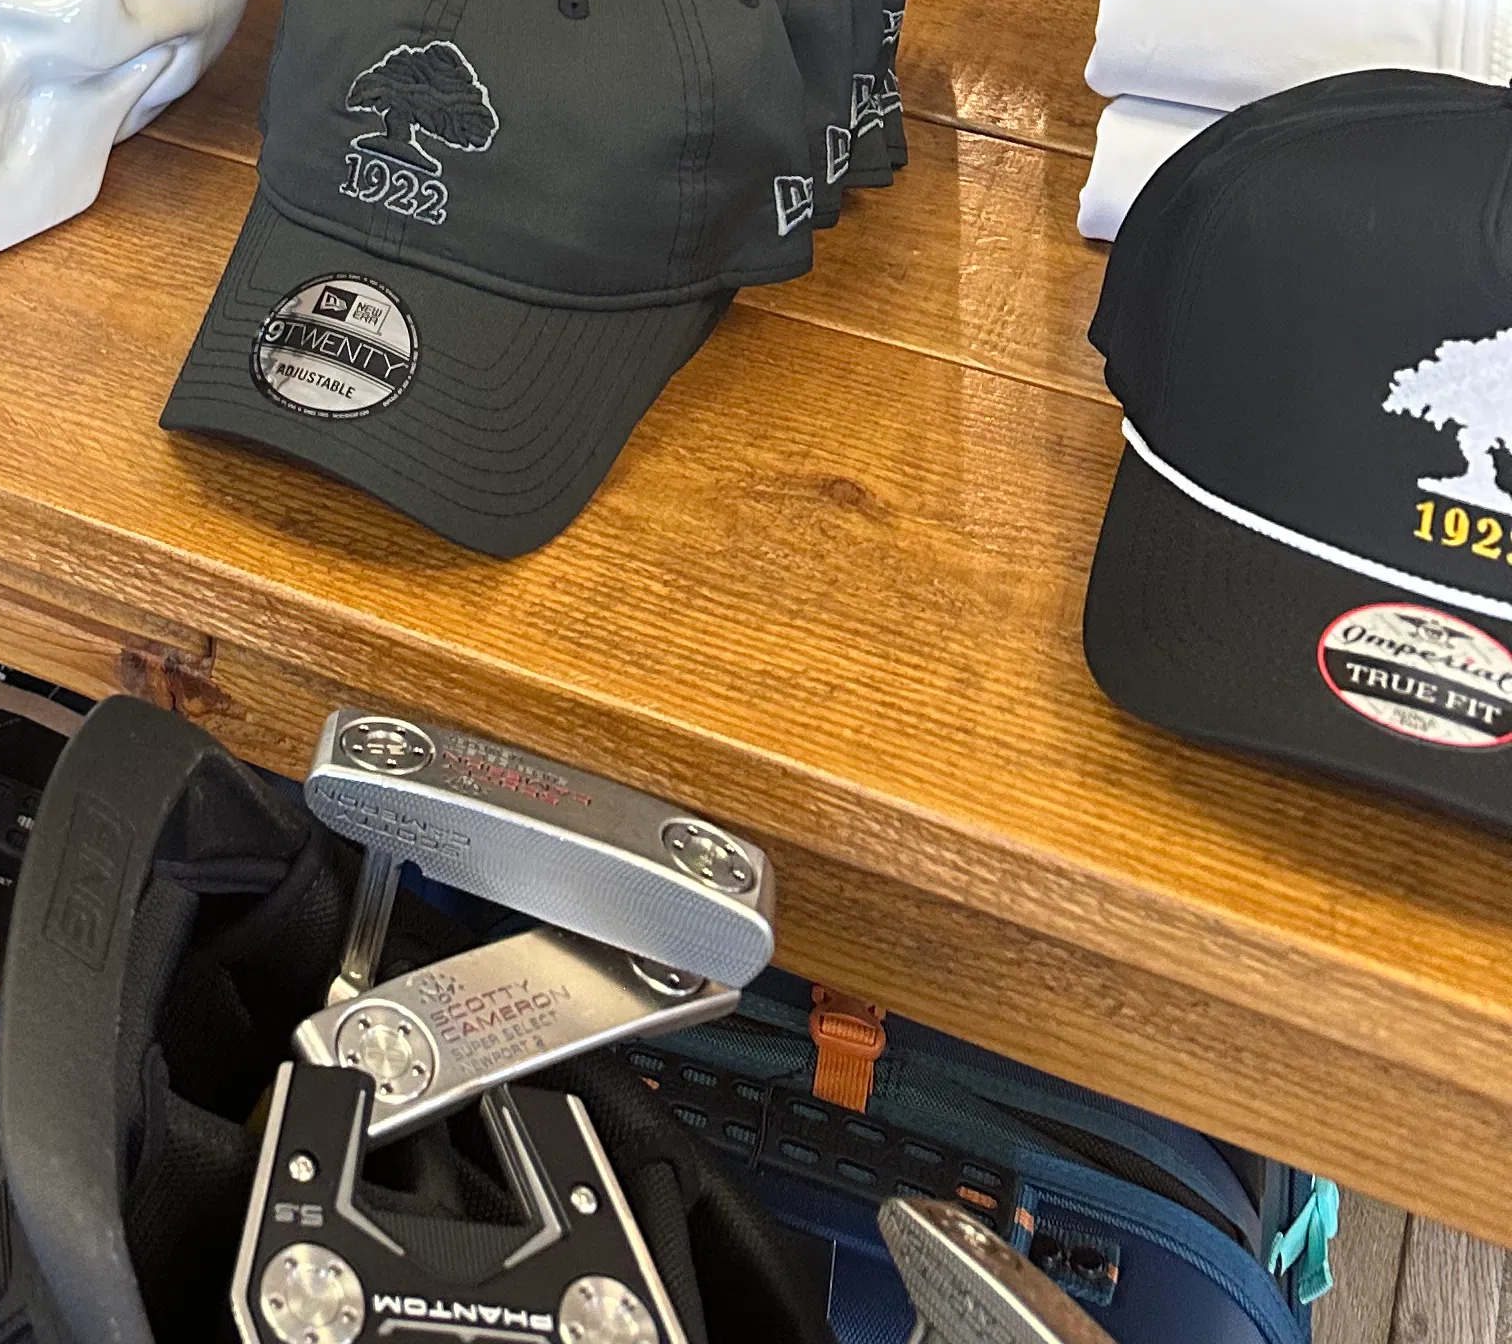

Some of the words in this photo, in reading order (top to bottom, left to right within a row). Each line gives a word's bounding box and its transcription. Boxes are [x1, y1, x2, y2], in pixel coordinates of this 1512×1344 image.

[339, 153, 448, 226] 1922
[353, 311, 379, 327] ERA
[356, 301, 383, 318] NEW
[265, 319, 410, 379] 9TWENTY
[275, 362, 356, 400] ADJUSTABLE
[1413, 501, 1512, 565] 192
[1346, 662, 1438, 704] TRUE
[1445, 690, 1502, 725] FIT
[430, 979, 529, 1028] SCOTTY
[440, 984, 572, 1043] CAMERON
[502, 1010, 558, 1041] SELECT
[372, 1292, 553, 1333] PHANTOM
